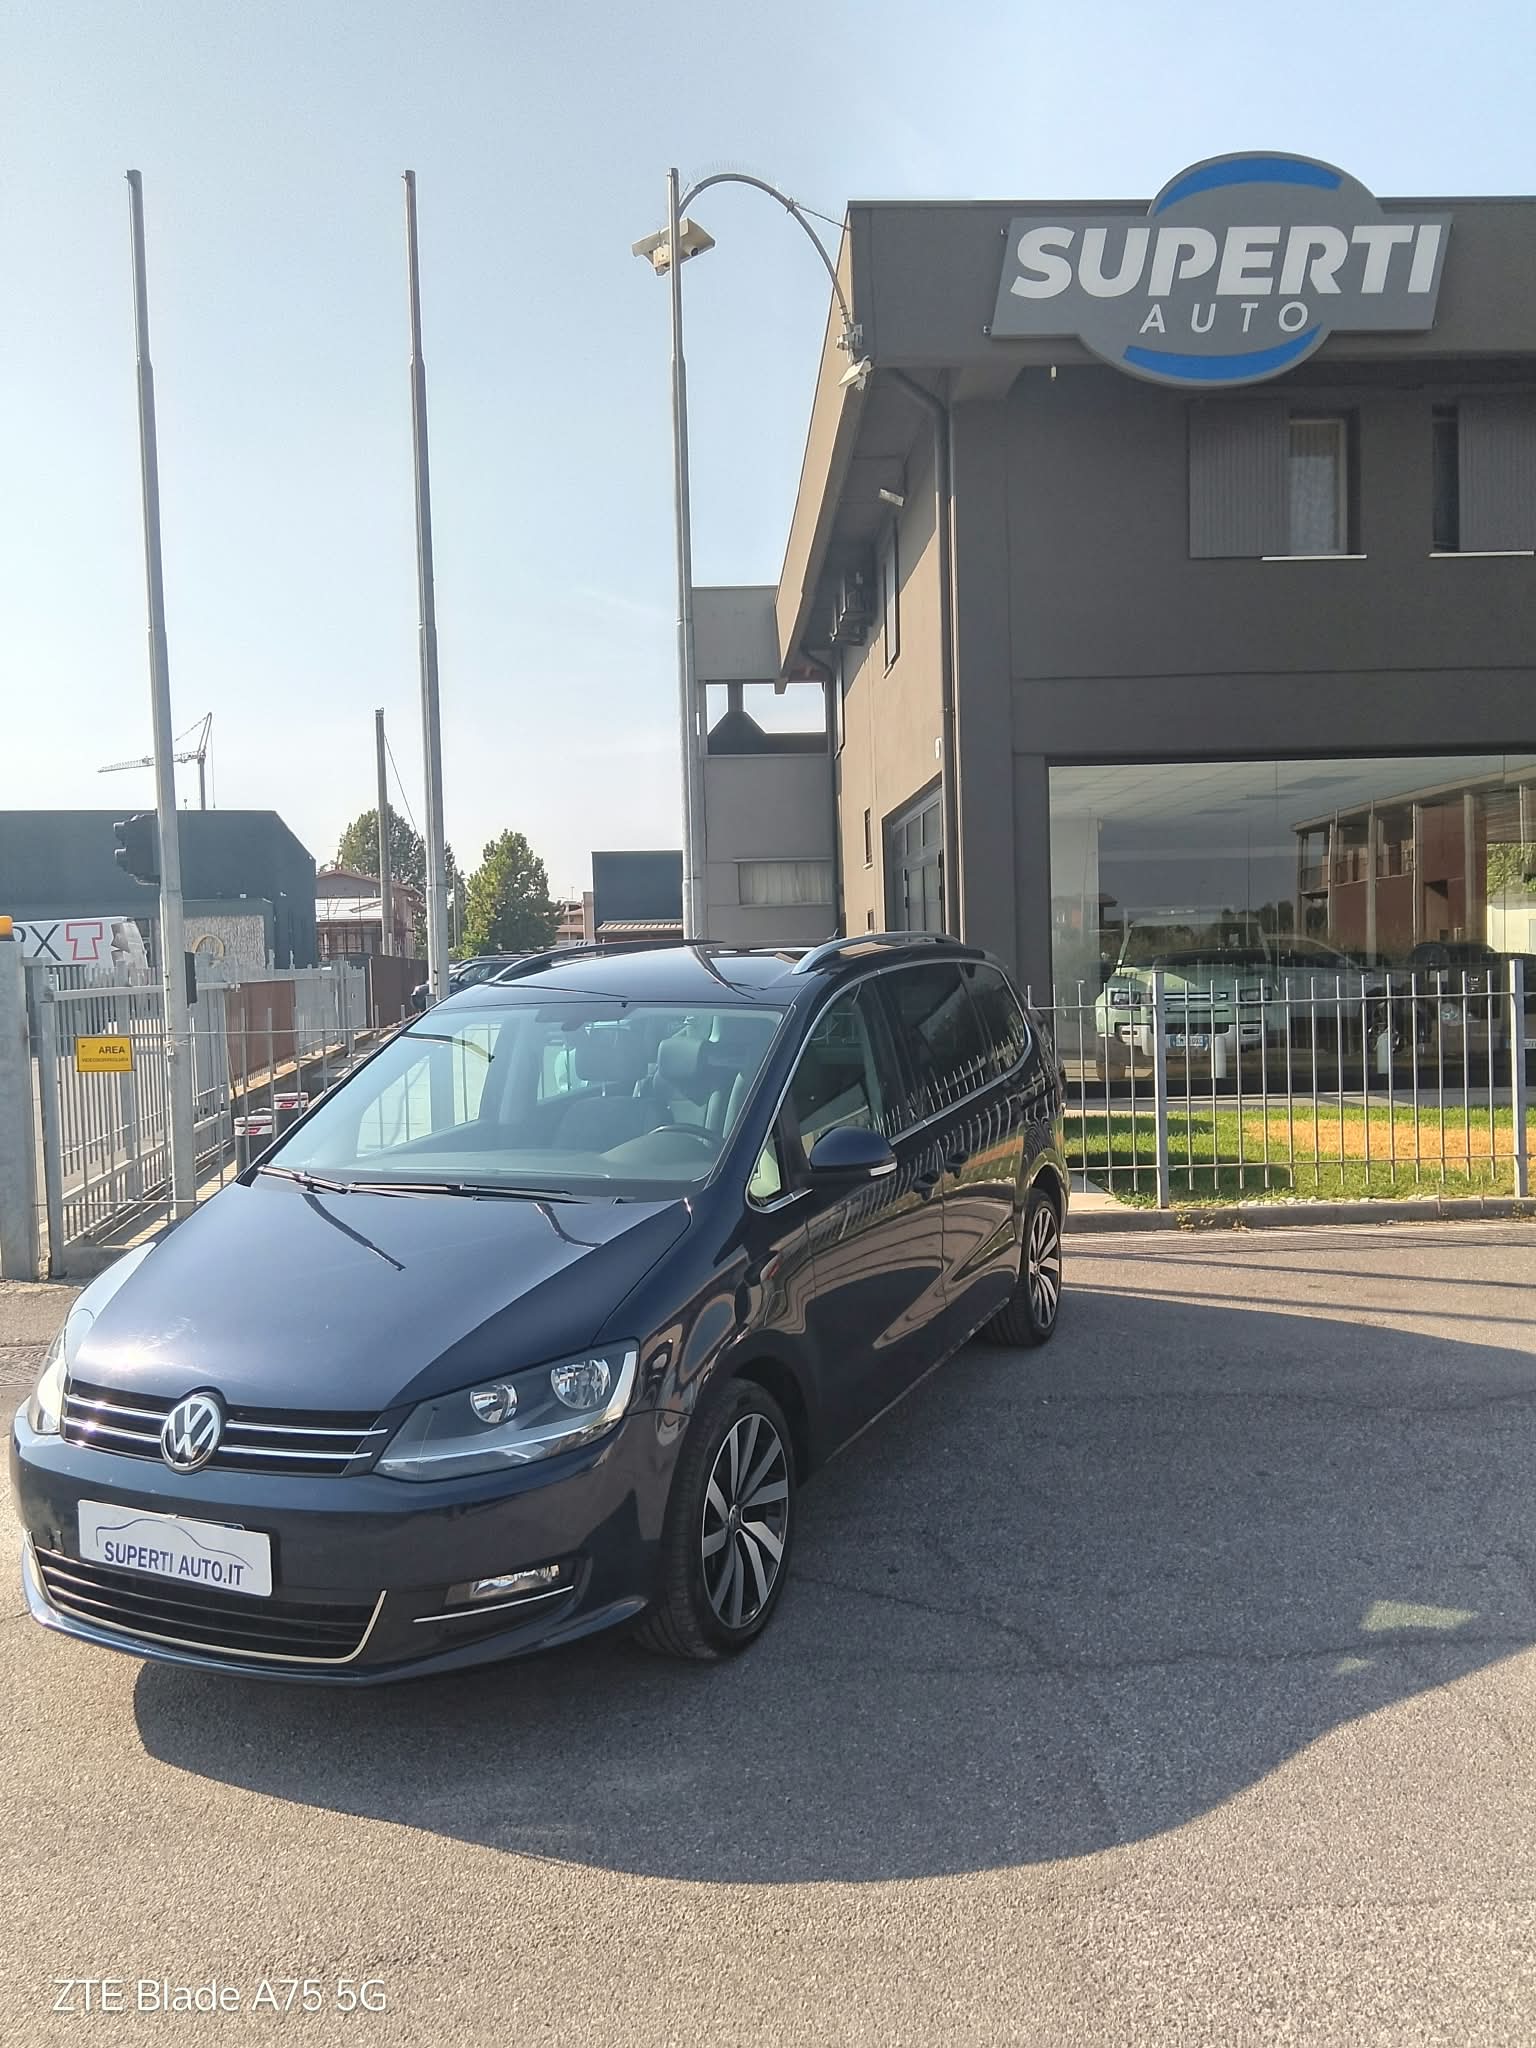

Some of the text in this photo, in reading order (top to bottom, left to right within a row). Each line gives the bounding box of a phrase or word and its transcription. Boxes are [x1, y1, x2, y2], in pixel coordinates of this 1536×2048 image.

[1009, 225, 1442, 299] SUPERTI
[1139, 302, 1309, 334] AUTO
[98, 1046, 126, 1054] AREA
[104, 1541, 244, 1586] SUPERTI AUTO.IT
